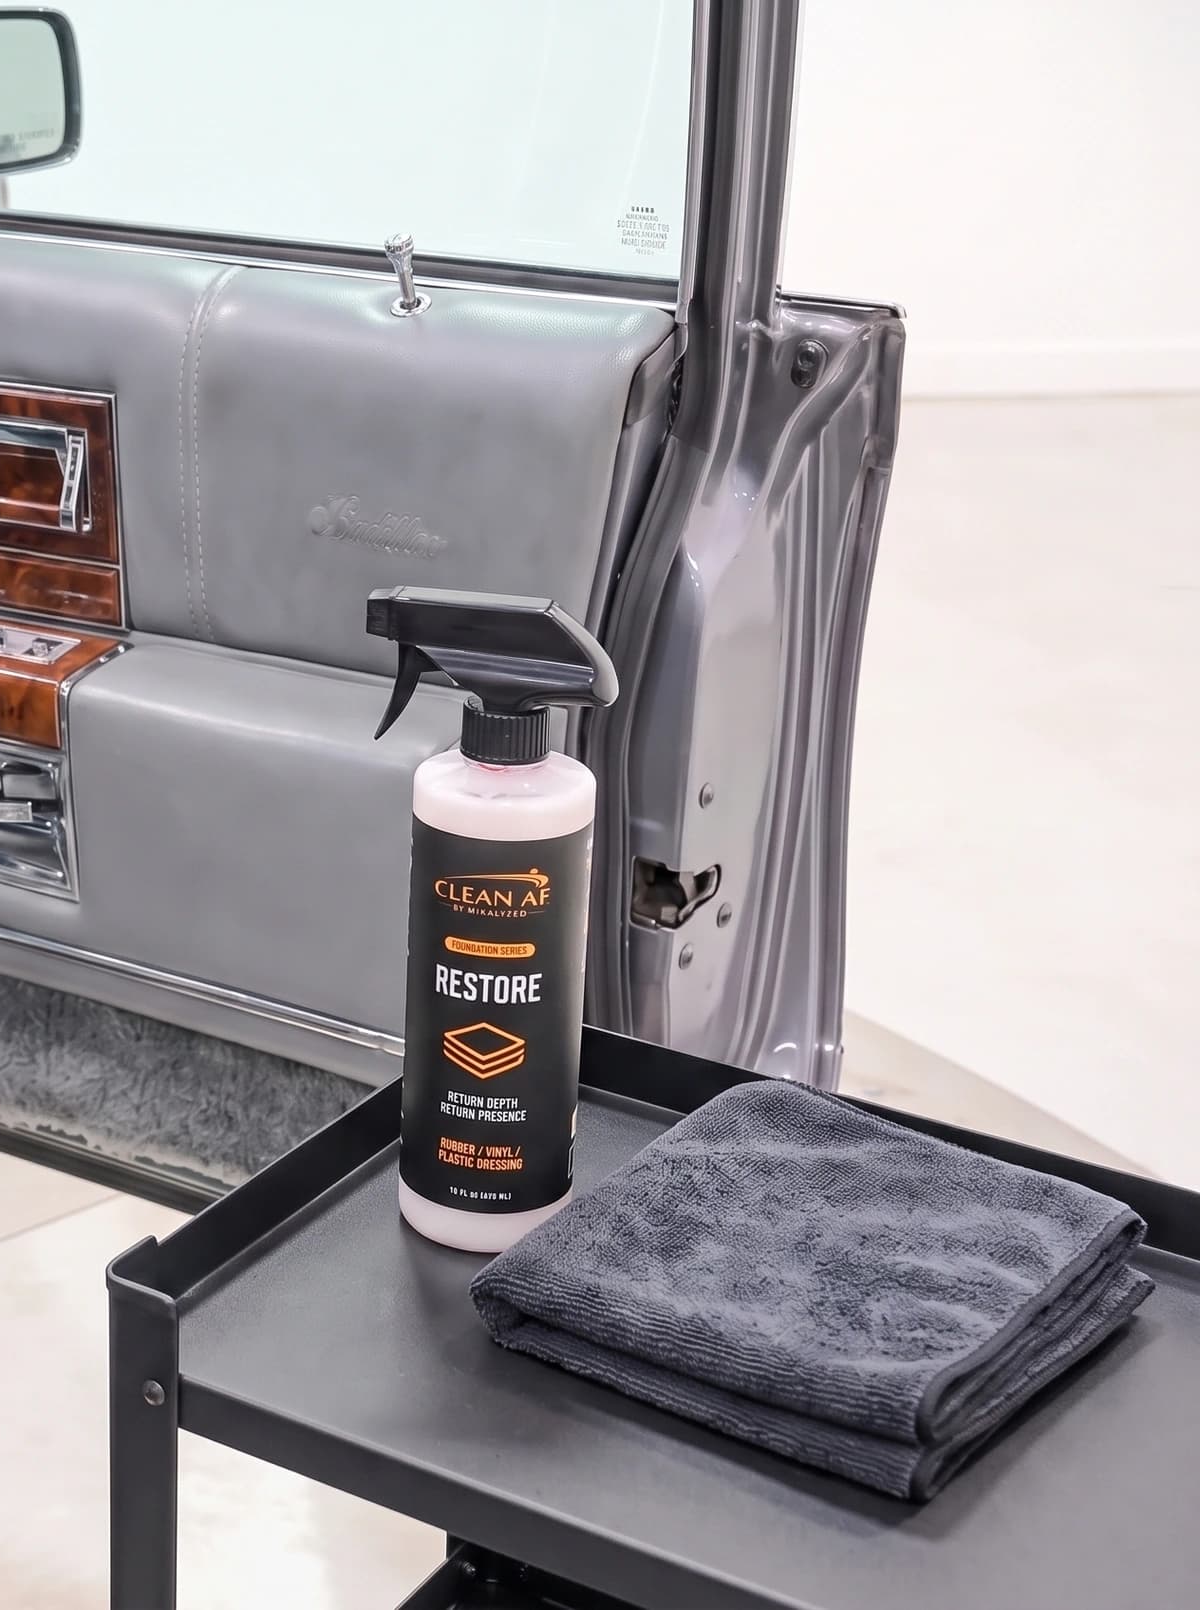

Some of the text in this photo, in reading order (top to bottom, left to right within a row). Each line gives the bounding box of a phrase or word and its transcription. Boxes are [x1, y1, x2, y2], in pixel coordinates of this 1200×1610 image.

[434, 879, 551, 907] CLEAN AF
[453, 904, 527, 918] BY MIKALYZED
[451, 939, 527, 956] FOUNDATION SERIES
[435, 963, 542, 1004] RESTORE
[447, 1090, 518, 1109] RETURN DEPTH
[440, 1101, 527, 1122] RETURN PRESENCE
[440, 1136, 475, 1156] RUBBER
[486, 1146, 513, 1158] VINYL
[438, 1149, 523, 1171] PLASTIC DRESSING
